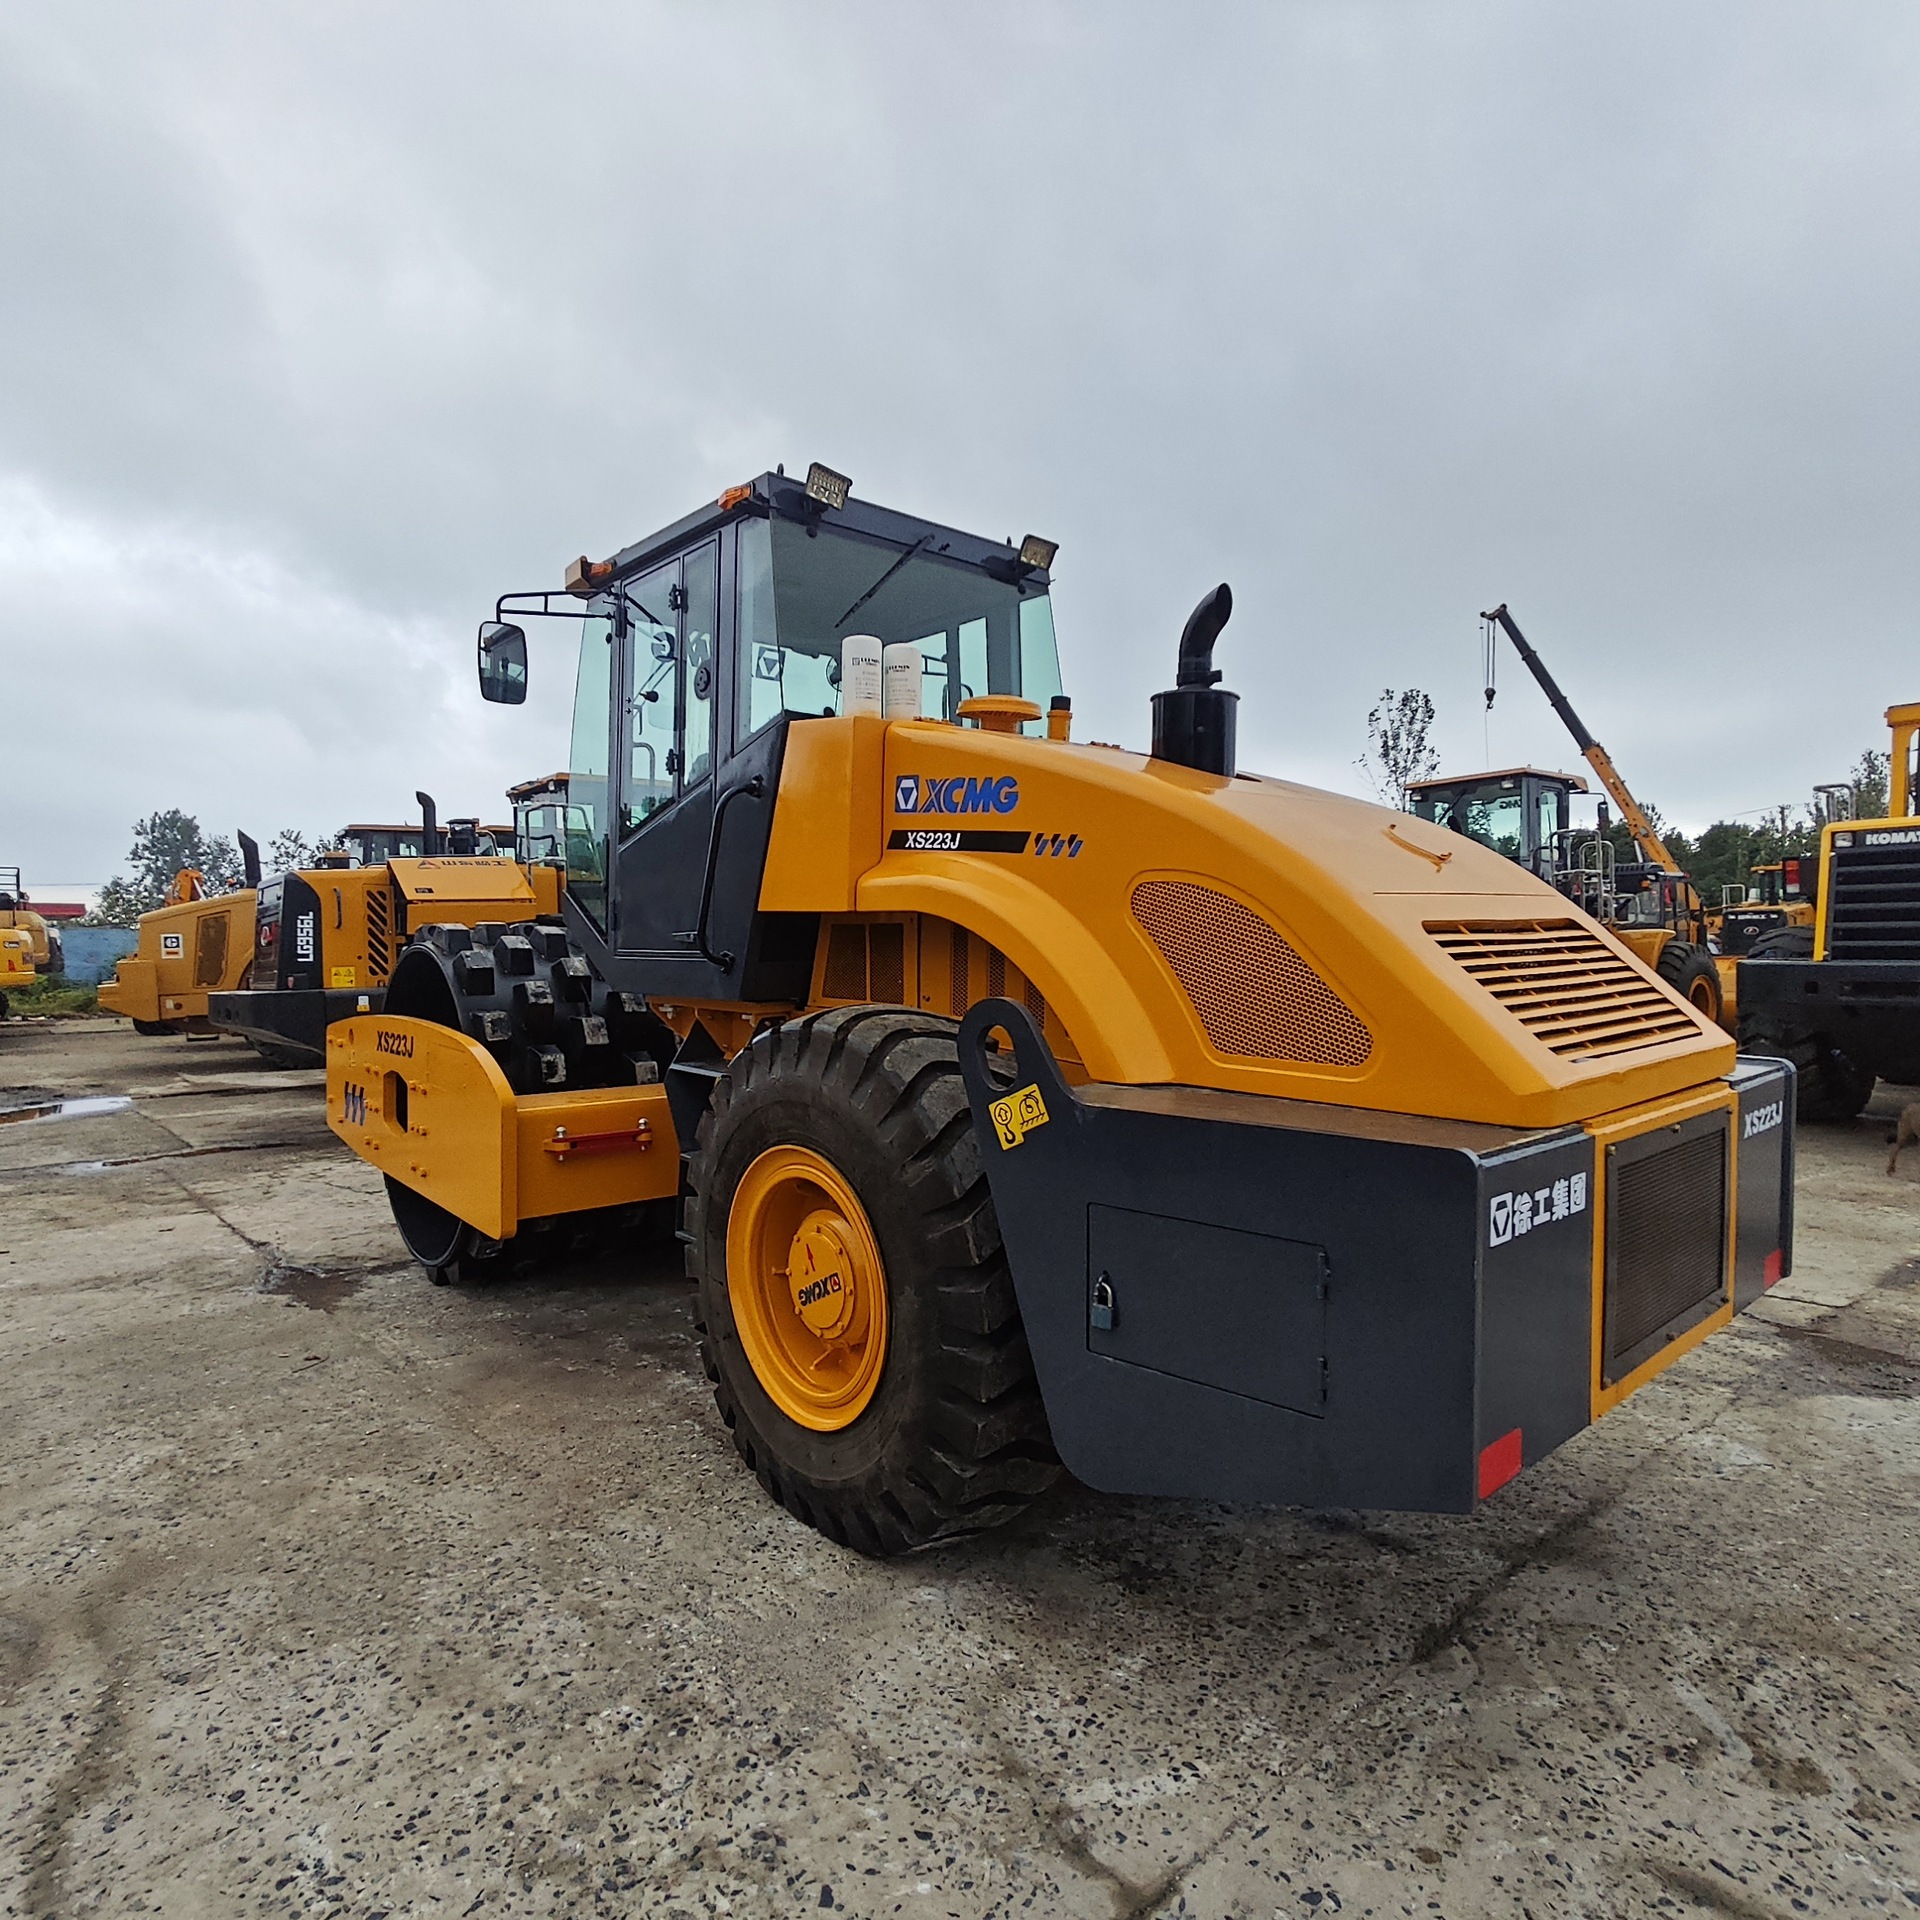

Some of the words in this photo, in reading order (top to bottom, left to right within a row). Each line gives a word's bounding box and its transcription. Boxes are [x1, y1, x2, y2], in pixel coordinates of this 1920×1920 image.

[918, 776, 1019, 813] XCMG
[905, 832, 961, 849] XS223J
[296, 911, 314, 961] LG956L
[376, 1030, 414, 1058] XS223J
[1744, 1101, 1783, 1139] XS223J
[1513, 1171, 1587, 1237] 徐工集团
[798, 1276, 830, 1306] XCMG
